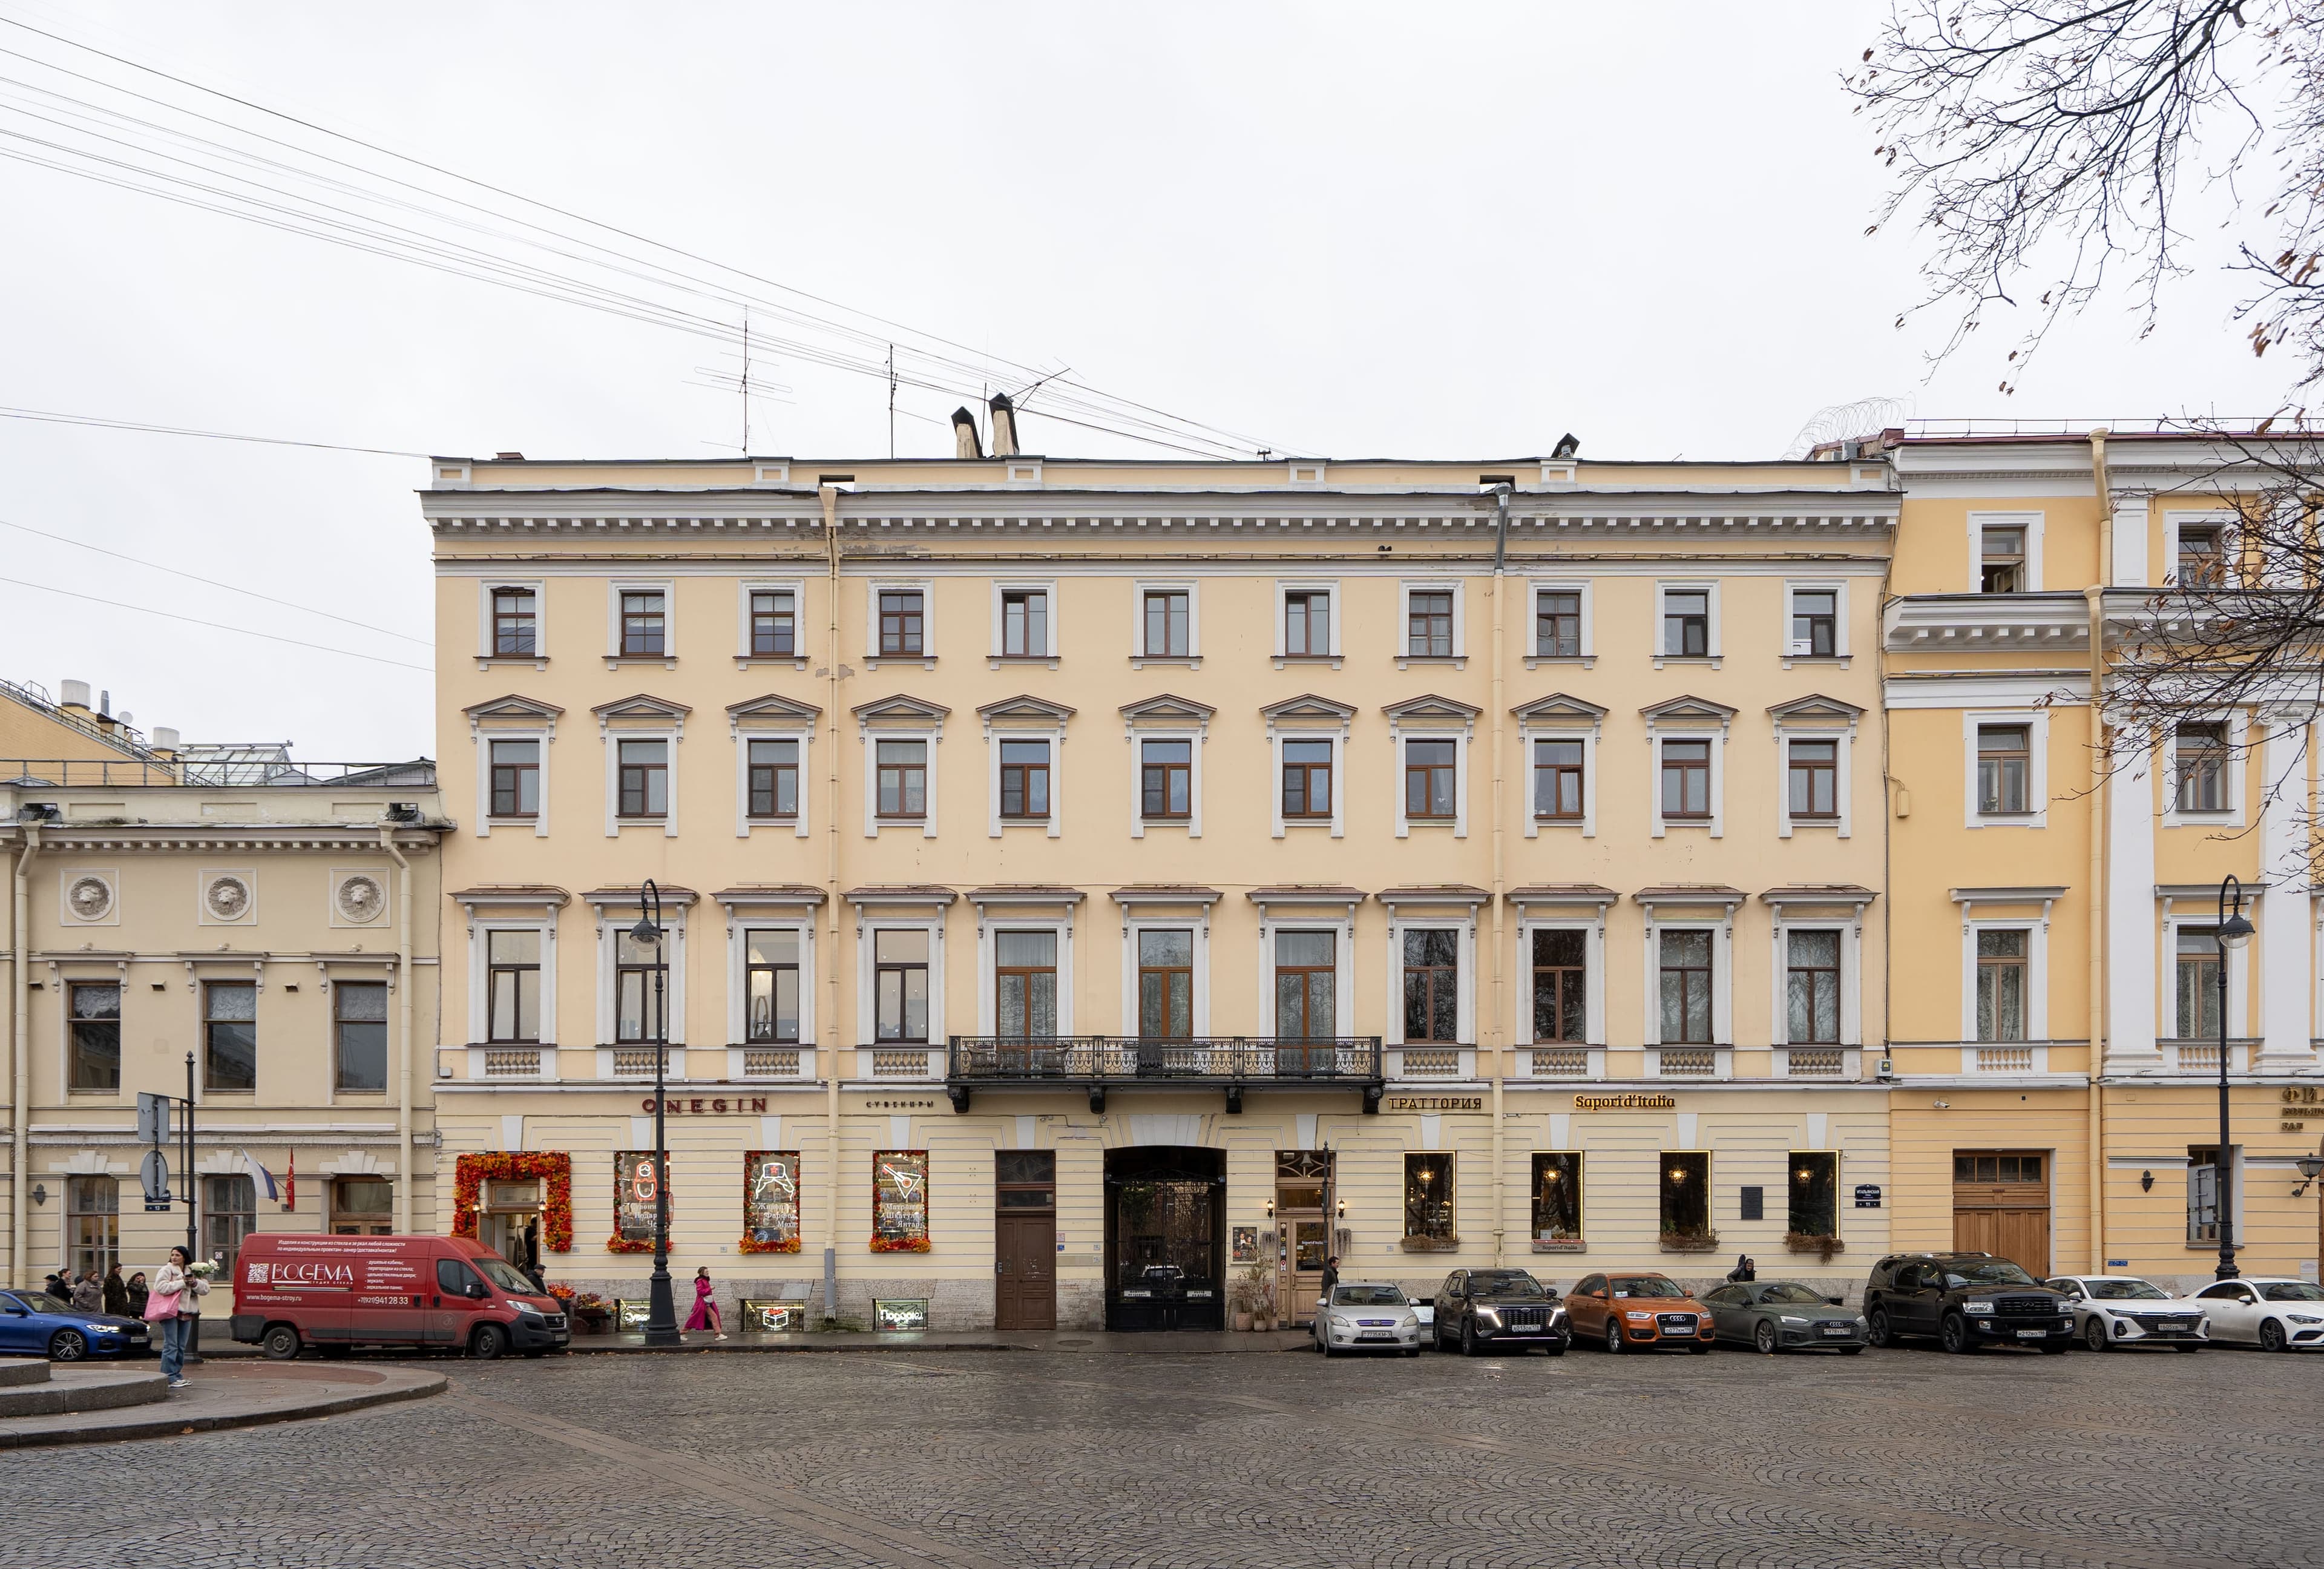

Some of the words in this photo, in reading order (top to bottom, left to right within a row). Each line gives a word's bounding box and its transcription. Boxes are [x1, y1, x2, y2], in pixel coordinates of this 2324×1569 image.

[2282, 1087, 2324, 1102] ФИ
[642, 1098, 766, 1113] ONEGIN
[1388, 1097, 1482, 1109] ТРАТТОРИЯ
[1576, 1095, 1622, 1111] Sapori
[1623, 1095, 1675, 1107] d'Italia
[2282, 1122, 2303, 1131] ЗАЛ
[272, 1263, 353, 1280] BOGEMA
